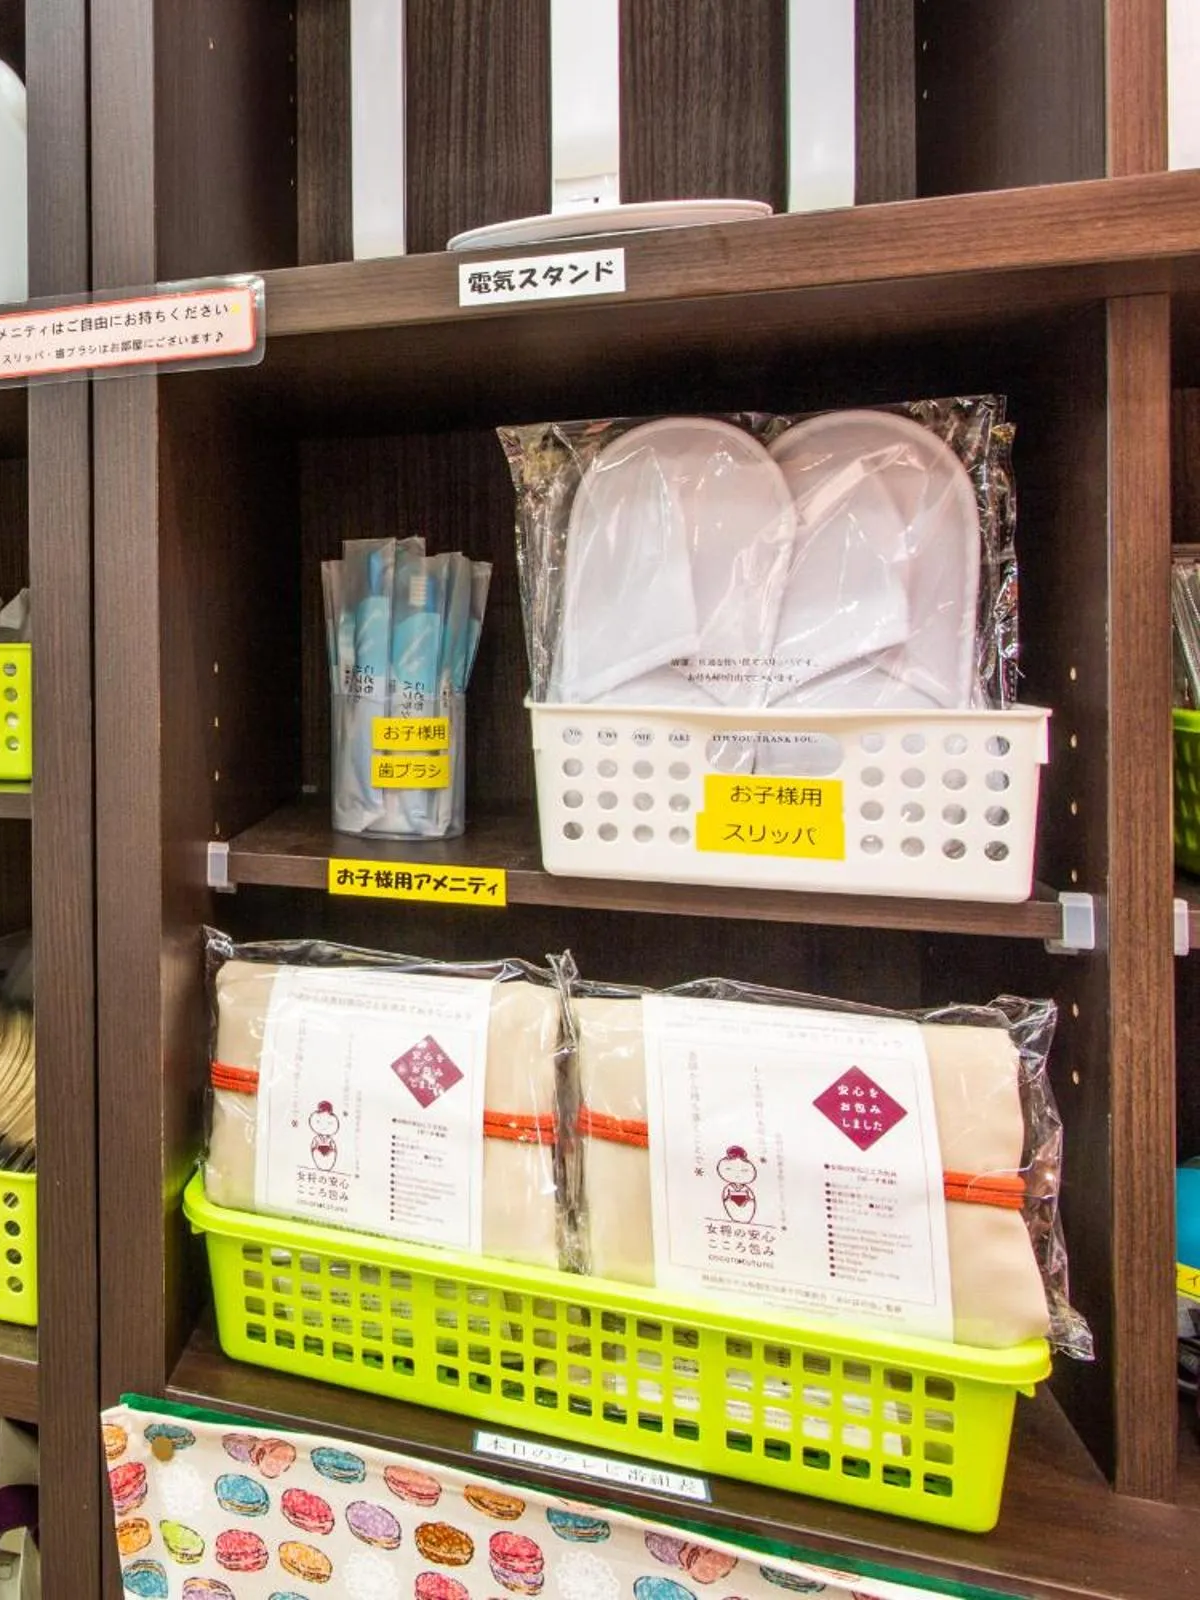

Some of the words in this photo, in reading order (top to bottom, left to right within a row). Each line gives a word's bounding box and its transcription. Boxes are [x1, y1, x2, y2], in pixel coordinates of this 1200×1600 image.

[468, 260, 614, 294] 電気スタンド
[383, 723, 447, 741] お子様用
[378, 762, 442, 779] 歯ブラシ
[729, 784, 823, 808] お子様用
[722, 823, 818, 847] スリッパ
[336, 867, 500, 897] お子様用アメニティ
[837, 1084, 879, 1099] 安心を
[840, 1102, 881, 1114] お包み
[841, 1117, 883, 1132] しました
